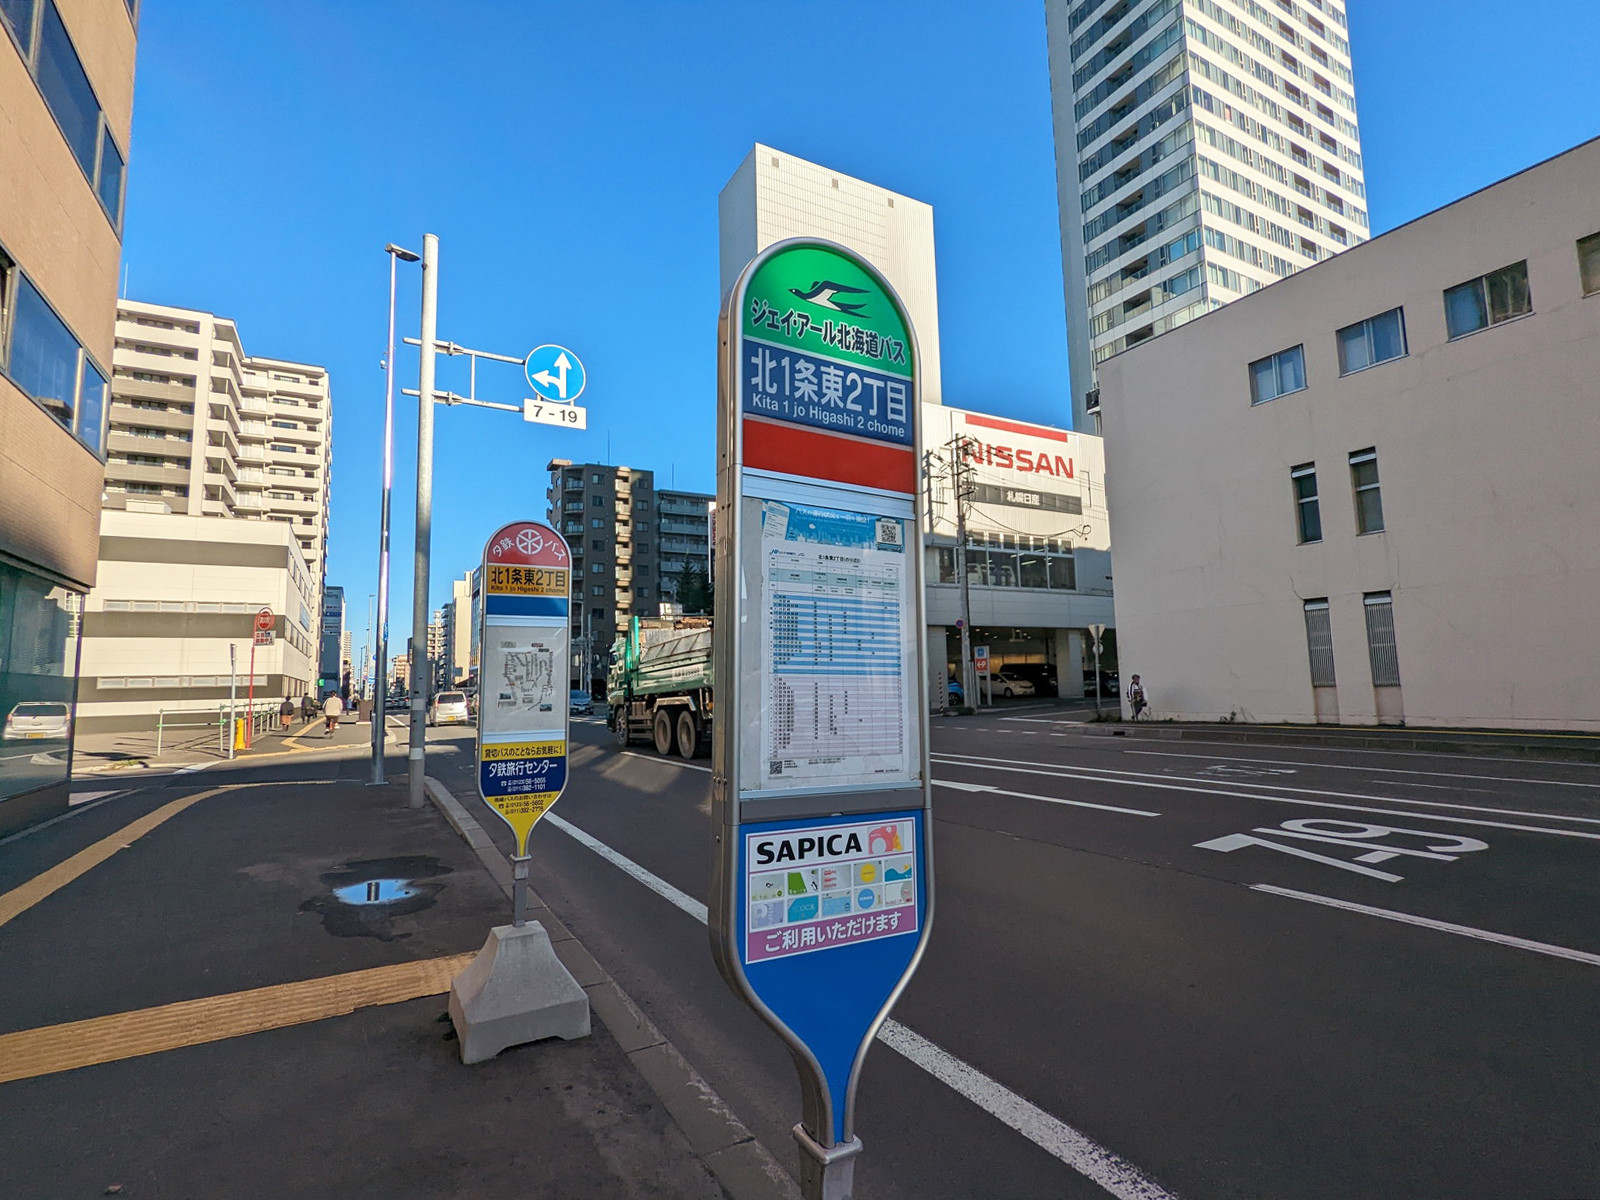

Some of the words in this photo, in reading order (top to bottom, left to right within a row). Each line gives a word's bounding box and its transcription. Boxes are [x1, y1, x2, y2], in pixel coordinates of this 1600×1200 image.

[751, 347, 907, 424] 北1条東2丁目
[752, 393, 779, 411] Kita
[783, 401, 789, 413] 1
[793, 403, 806, 418] jo
[809, 408, 854, 428] Higashi
[858, 416, 865, 429] 2
[867, 419, 905, 438] chome
[961, 439, 1074, 479] NISSAN
[491, 566, 566, 587] 北1条東2丁目
[488, 759, 558, 778] 夕鉄旅行センター
[756, 832, 863, 865] SAPICA
[765, 911, 902, 952] ご利用いただけます
